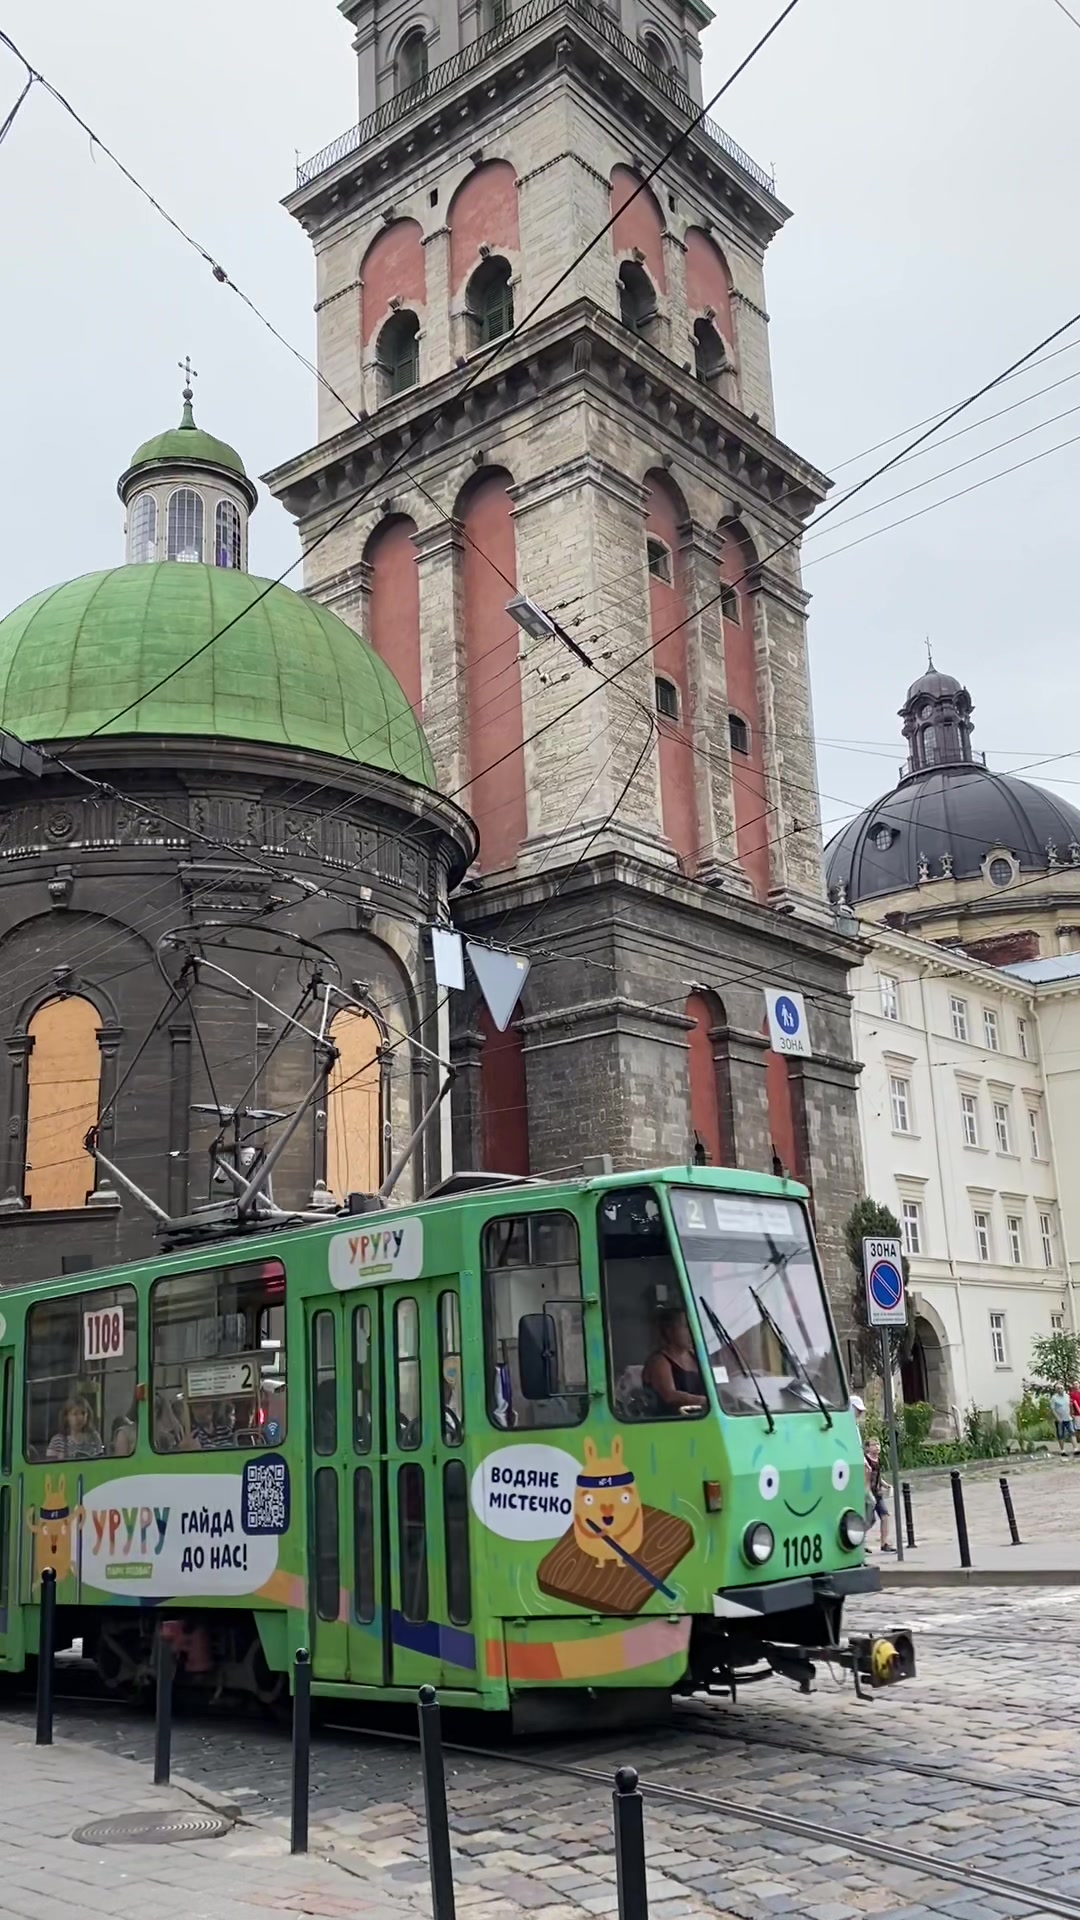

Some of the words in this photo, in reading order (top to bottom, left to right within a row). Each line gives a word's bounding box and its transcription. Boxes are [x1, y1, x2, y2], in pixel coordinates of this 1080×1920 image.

[780, 1037, 804, 1052] ЗОНА
[687, 1200, 701, 1222] 2
[347, 1229, 404, 1265] УРУРУ
[870, 1243, 897, 1257] ЗОНА
[88, 1312, 120, 1355] 1108
[241, 1364, 252, 1389] 2
[491, 1466, 560, 1488] ВОДЯНЕ
[489, 1492, 572, 1515] МІСТЕЧКО
[91, 1506, 171, 1556] УРУРУ
[181, 1505, 235, 1539] ГАЙДА
[181, 1545, 205, 1573] ДО
[210, 1543, 248, 1572] НАС!
[783, 1533, 823, 1568] 1108
